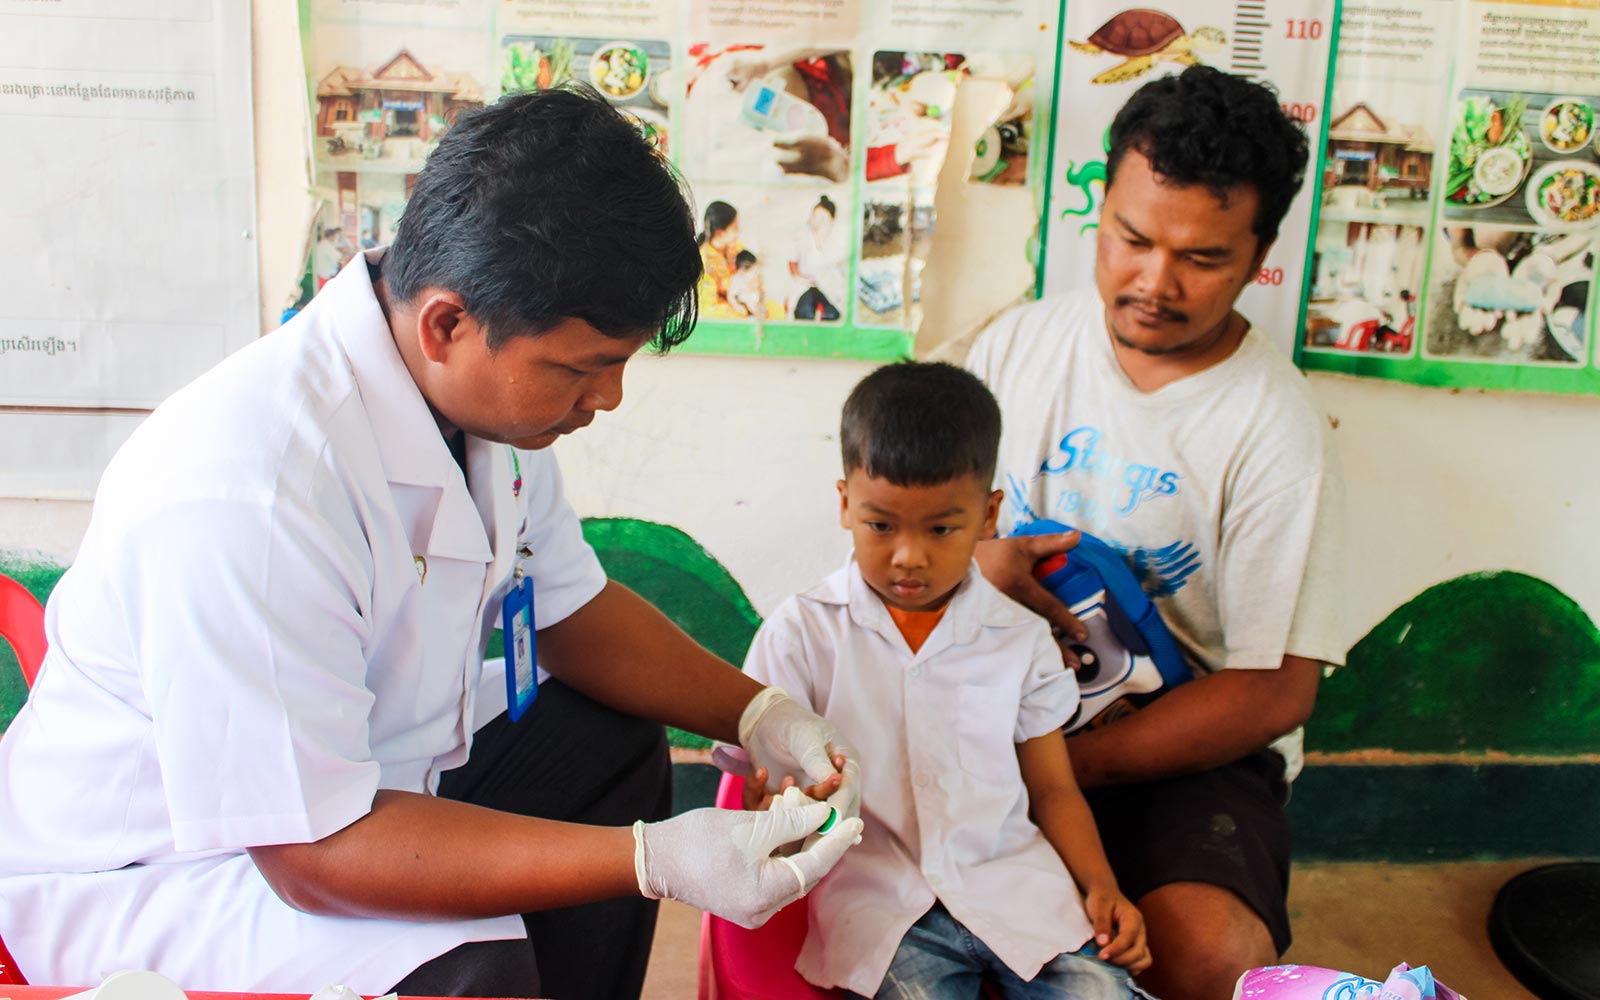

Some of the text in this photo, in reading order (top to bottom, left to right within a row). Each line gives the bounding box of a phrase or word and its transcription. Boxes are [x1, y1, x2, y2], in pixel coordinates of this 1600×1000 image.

[1285, 19, 1323, 40] 110
[1257, 268, 1284, 286] 80
[1037, 426, 1180, 515] Stgis
